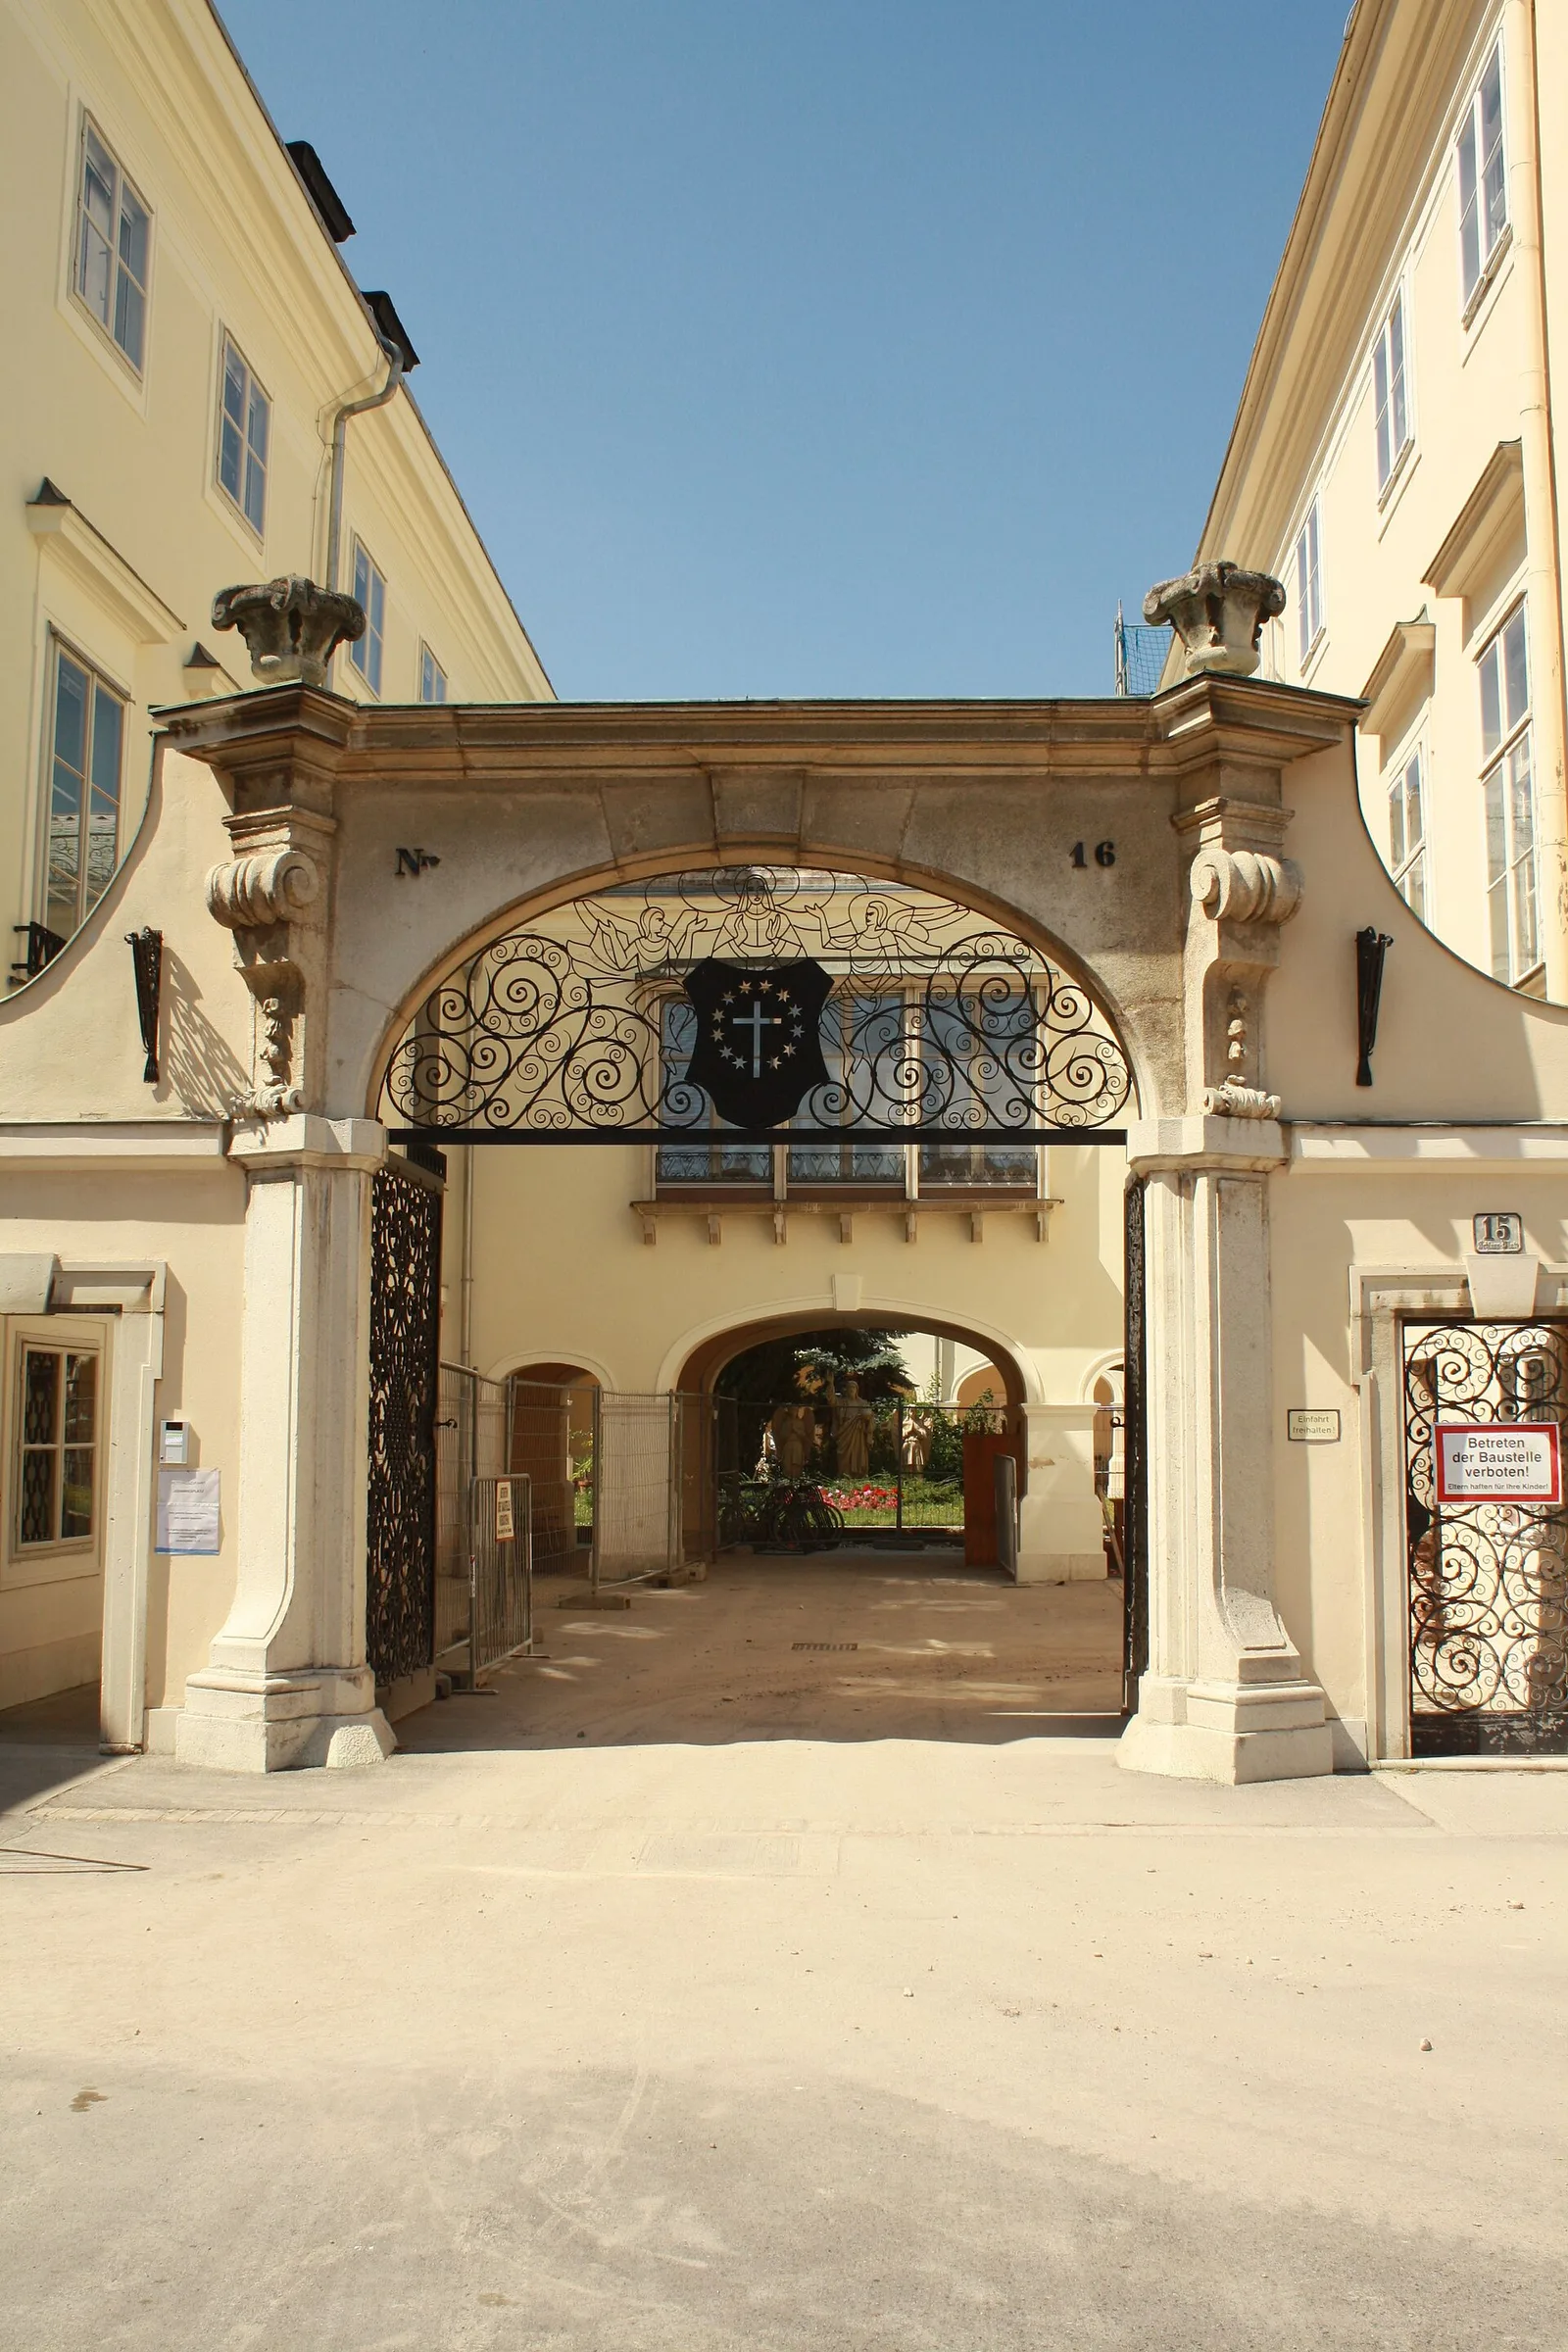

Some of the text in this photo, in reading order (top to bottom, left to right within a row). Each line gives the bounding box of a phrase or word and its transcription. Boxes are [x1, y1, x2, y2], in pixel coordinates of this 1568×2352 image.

[1069, 841, 1115, 868] 16
[1482, 1215, 1511, 1241] 15
[1468, 1438, 1525, 1448] Betreten
[1452, 1451, 1542, 1463] der Baustelle
[1465, 1466, 1529, 1477] verboten!
